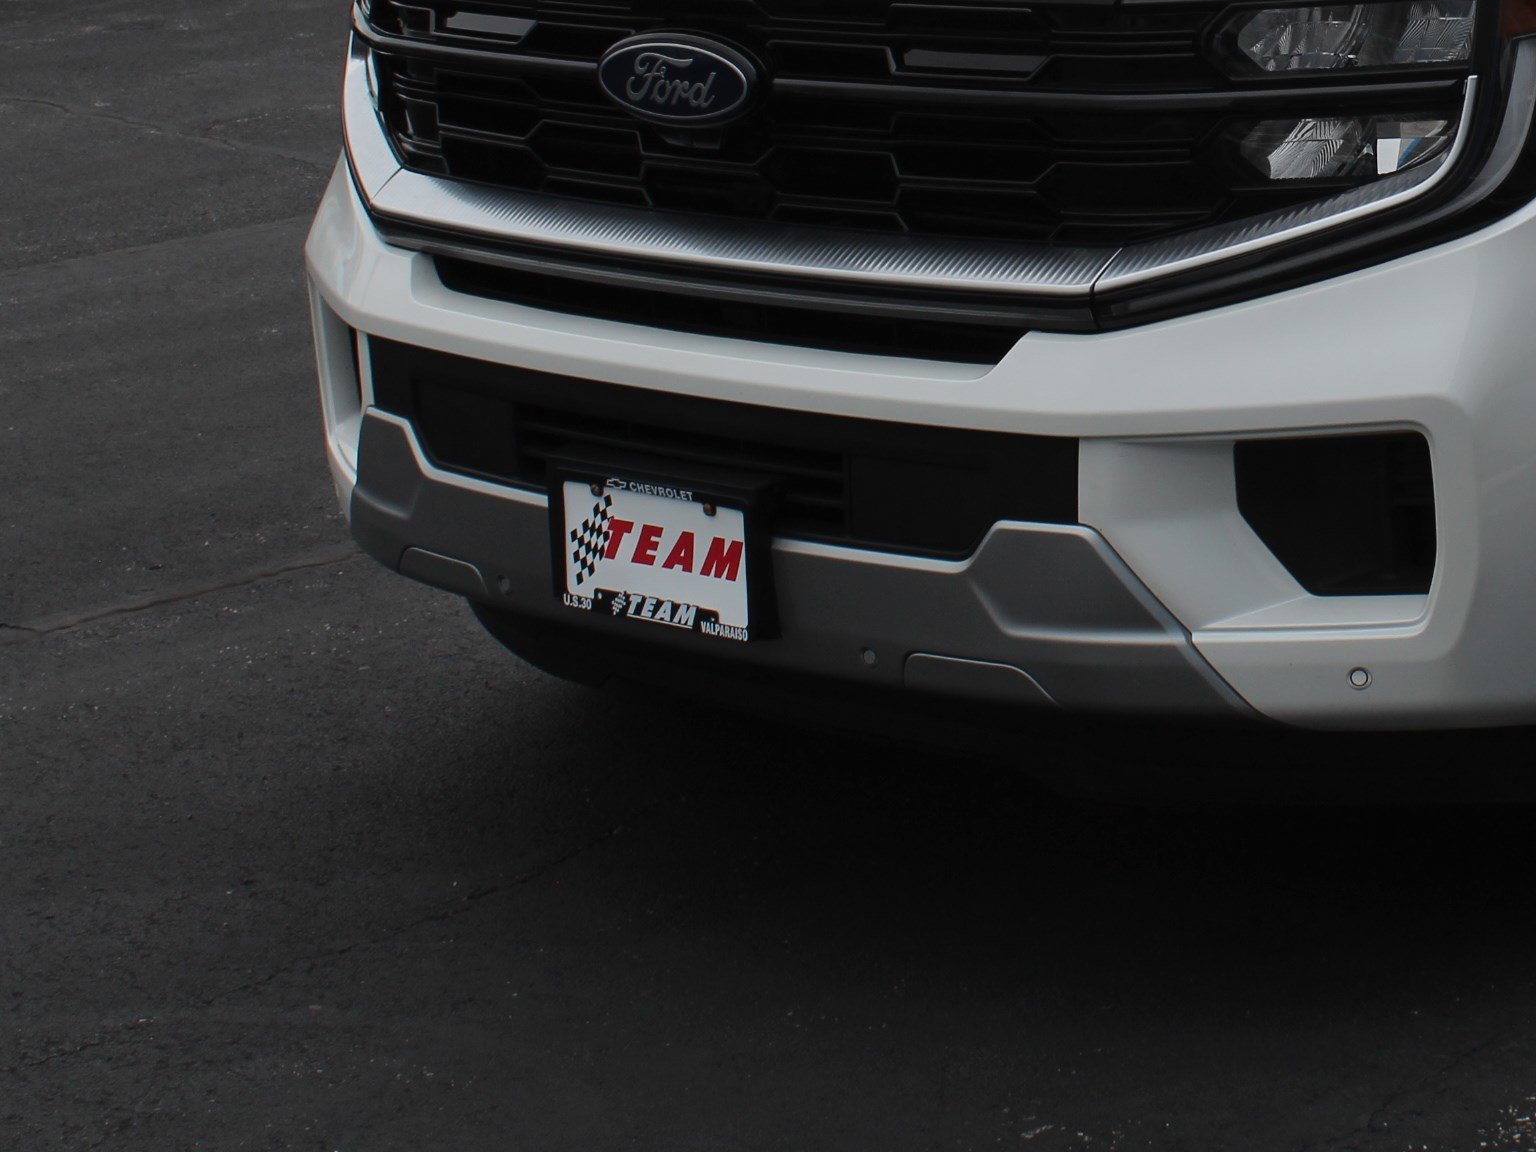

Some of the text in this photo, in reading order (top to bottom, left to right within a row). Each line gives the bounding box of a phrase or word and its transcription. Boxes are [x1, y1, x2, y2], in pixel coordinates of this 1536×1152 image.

[625, 52, 717, 109] Ford
[629, 481, 694, 502] CHEVROLET
[603, 518, 744, 582] TEAM
[626, 593, 699, 627] TEAM
[700, 620, 748, 641] VALPARAISO
